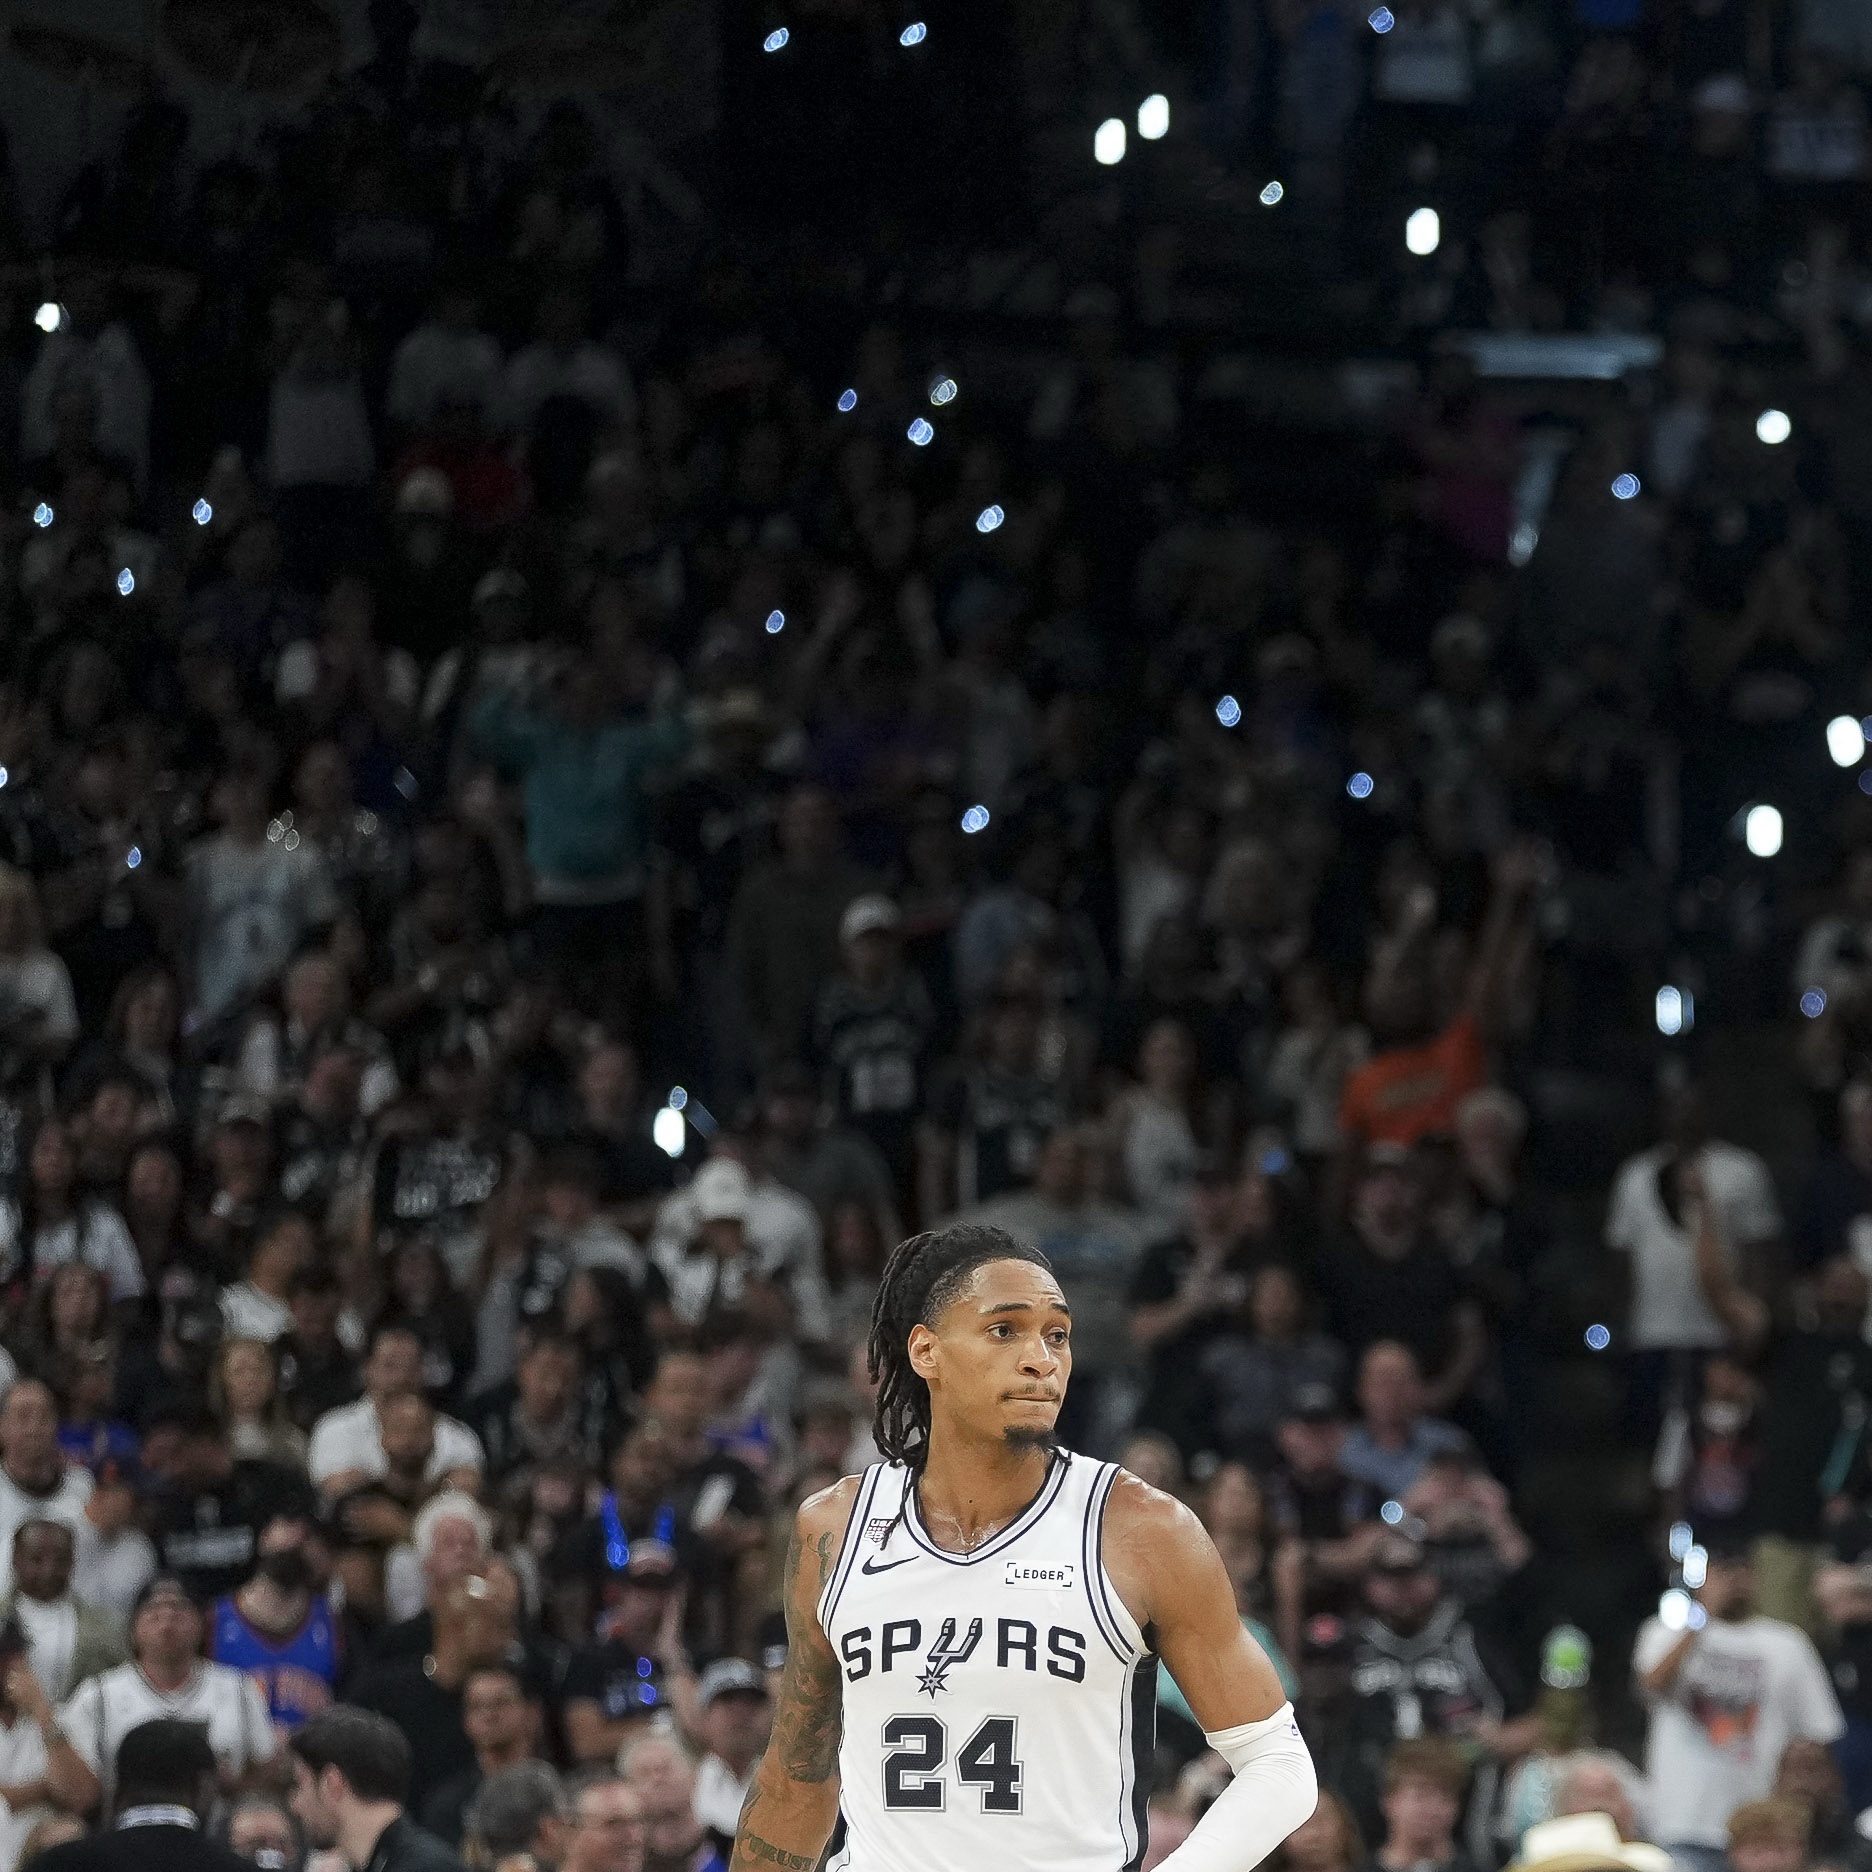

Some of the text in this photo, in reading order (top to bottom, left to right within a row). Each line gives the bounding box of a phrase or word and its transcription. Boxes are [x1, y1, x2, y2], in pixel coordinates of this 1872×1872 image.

[1014, 1567, 1065, 1582] LEDGER
[841, 1617, 1087, 1699] SPURS
[881, 1713, 1025, 1815] 24
